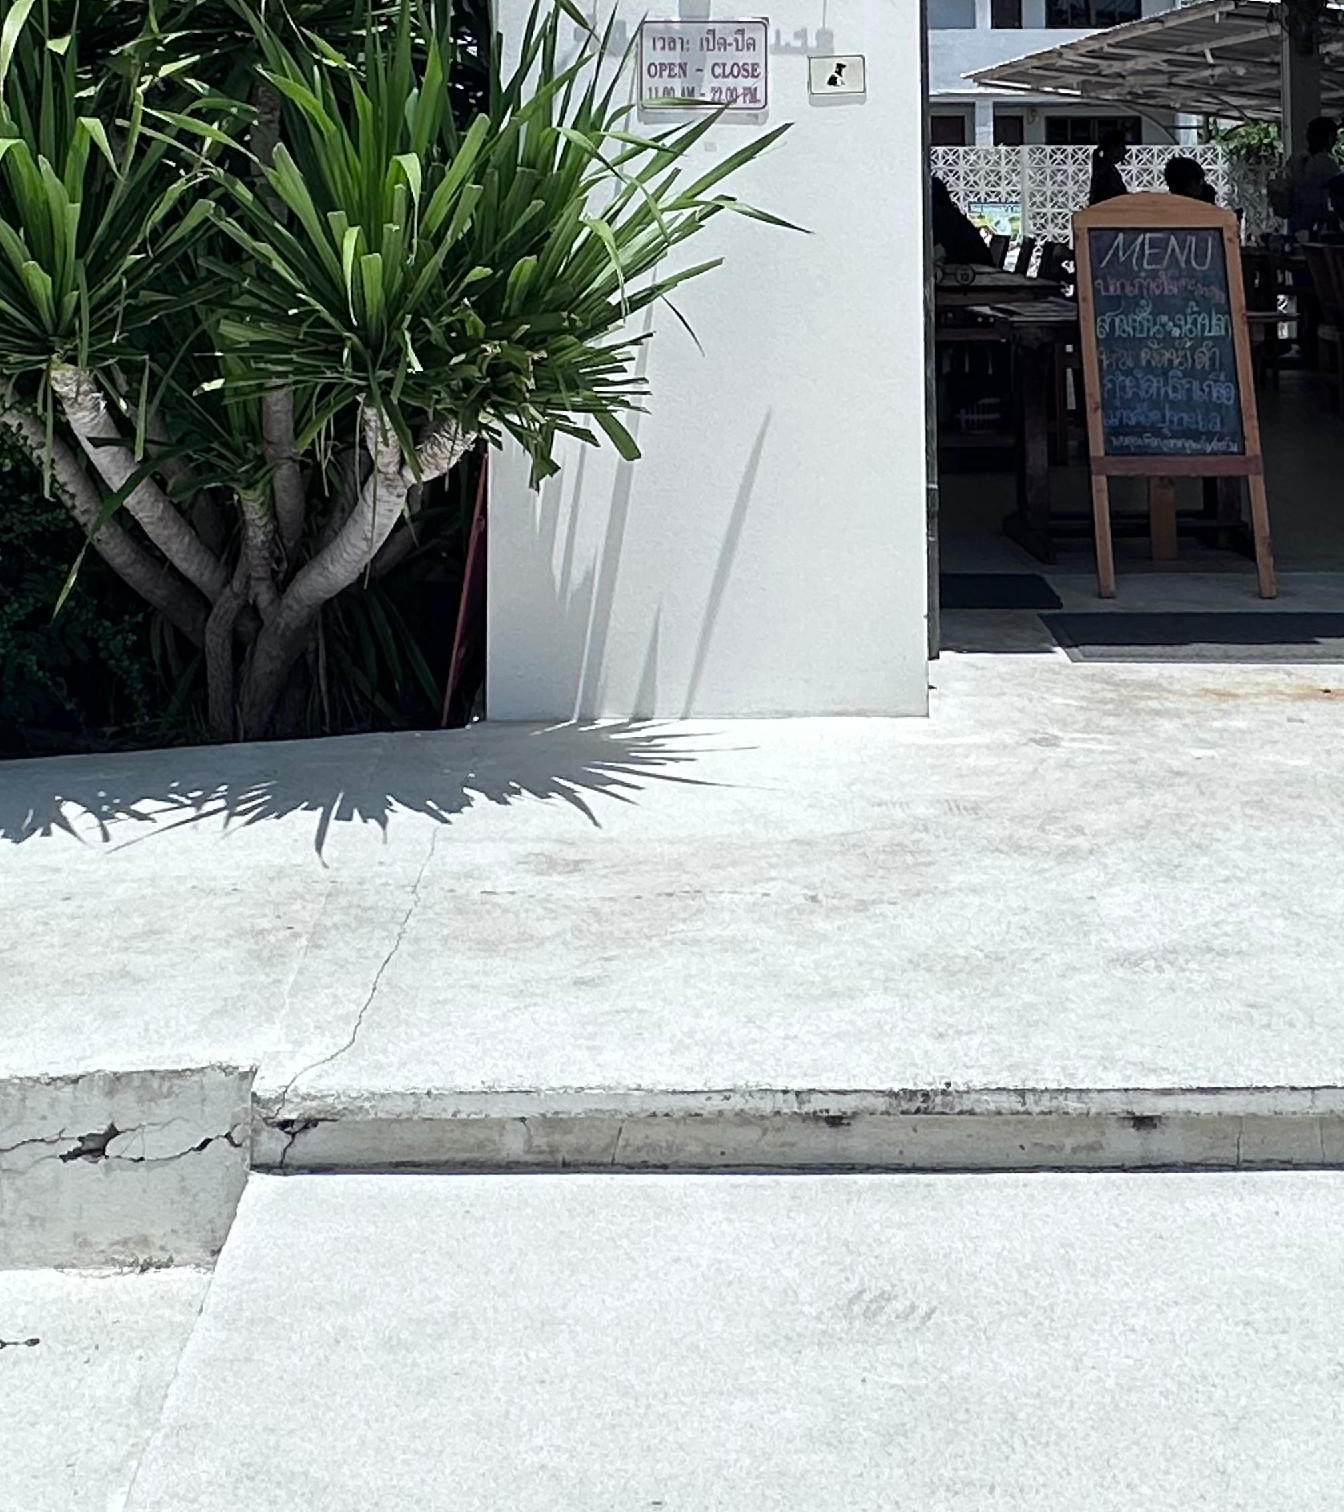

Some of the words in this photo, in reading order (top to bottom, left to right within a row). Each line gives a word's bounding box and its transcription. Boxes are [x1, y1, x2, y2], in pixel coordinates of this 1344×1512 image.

[647, 62, 688, 79] OPEN
[711, 62, 761, 79] CLOSE
[1099, 232, 1213, 271] MENU
